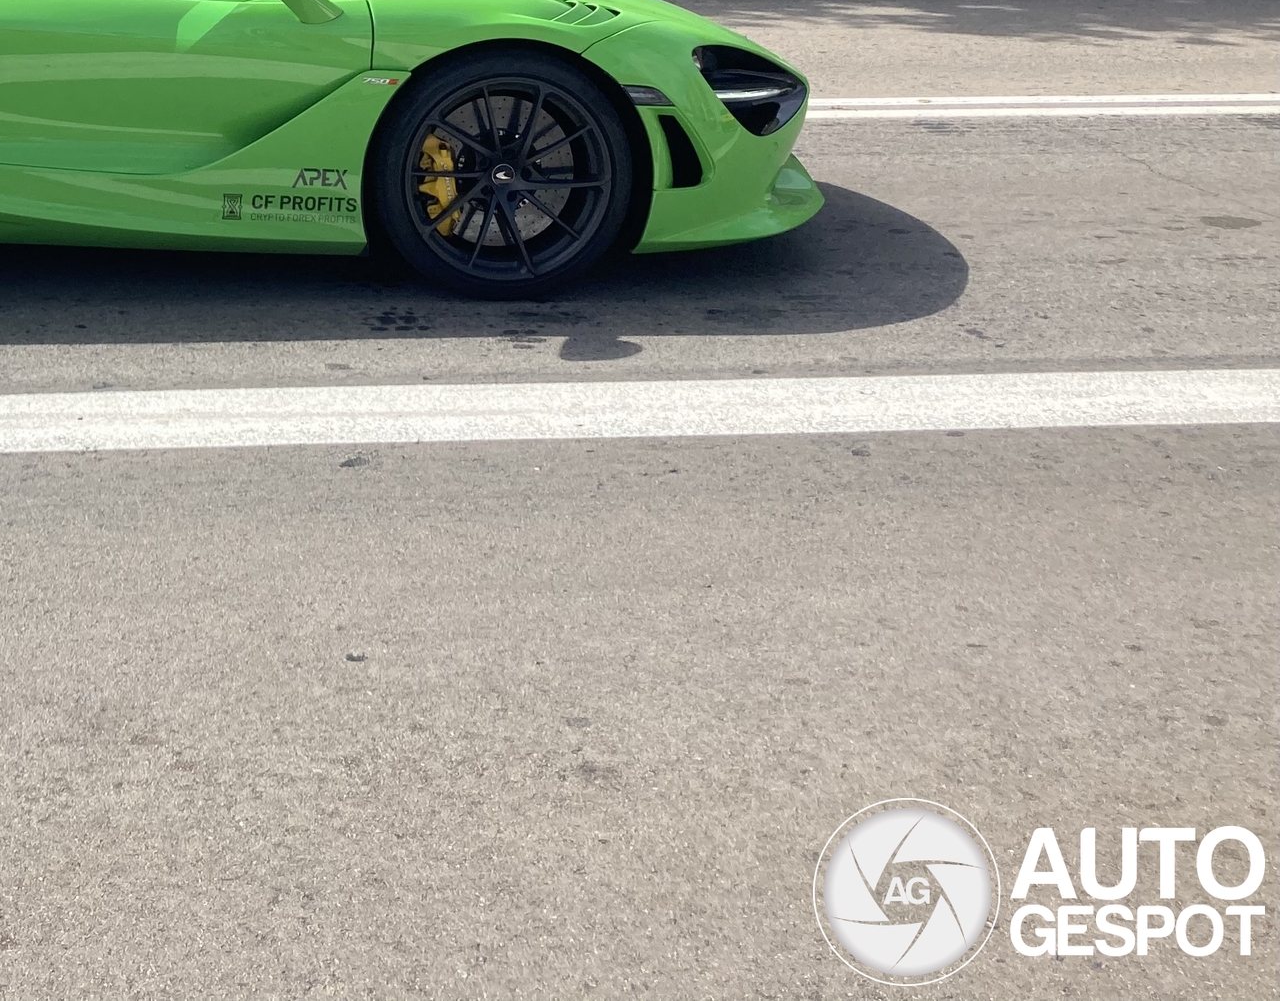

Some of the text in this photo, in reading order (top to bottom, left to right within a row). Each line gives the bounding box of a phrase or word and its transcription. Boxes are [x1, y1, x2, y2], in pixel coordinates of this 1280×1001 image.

[292, 168, 348, 190] APEX
[252, 194, 358, 212] CF PROFITS
[250, 212, 357, 224] CRYPTO FOREX PROFITS
